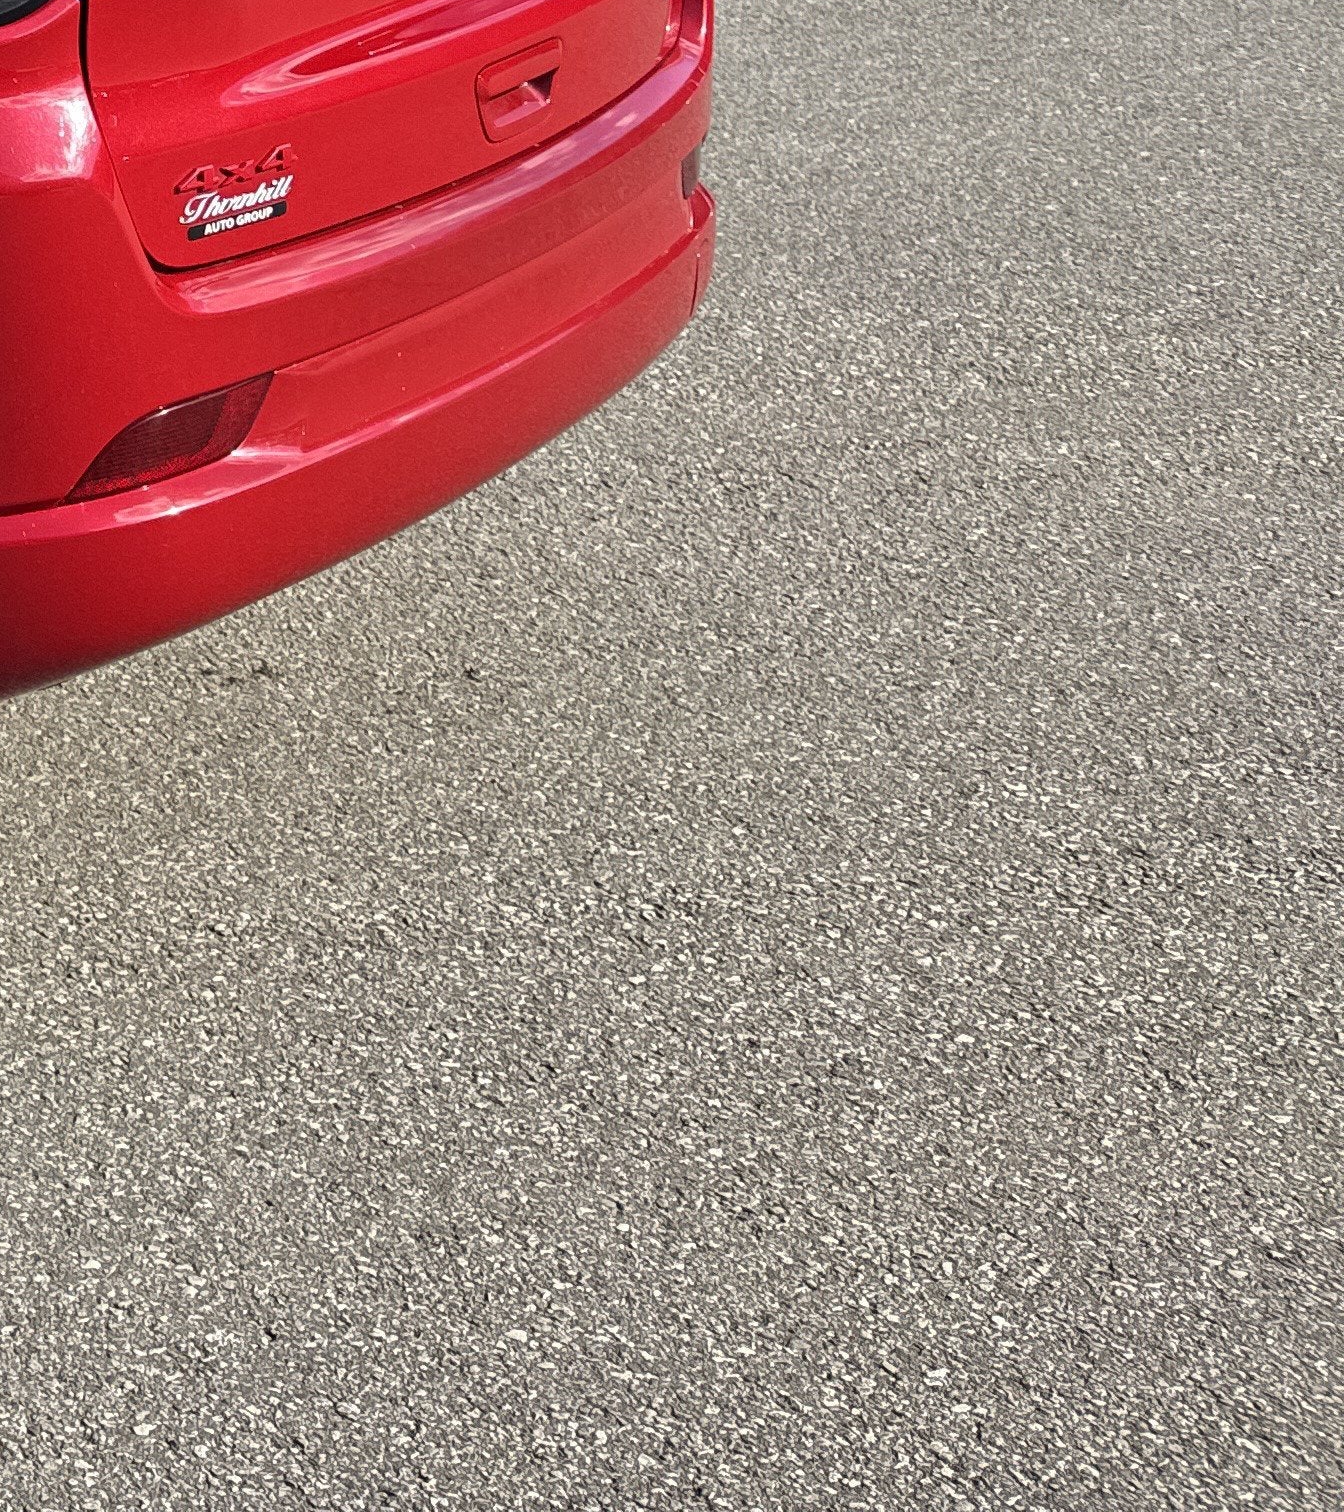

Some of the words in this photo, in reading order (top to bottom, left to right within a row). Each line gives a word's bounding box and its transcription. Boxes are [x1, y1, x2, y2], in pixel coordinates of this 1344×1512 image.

[173, 144, 298, 194] 4x4
[179, 174, 293, 225] Thornhill
[204, 217, 234, 235] AUTO
[236, 207, 273, 226] GROUP
